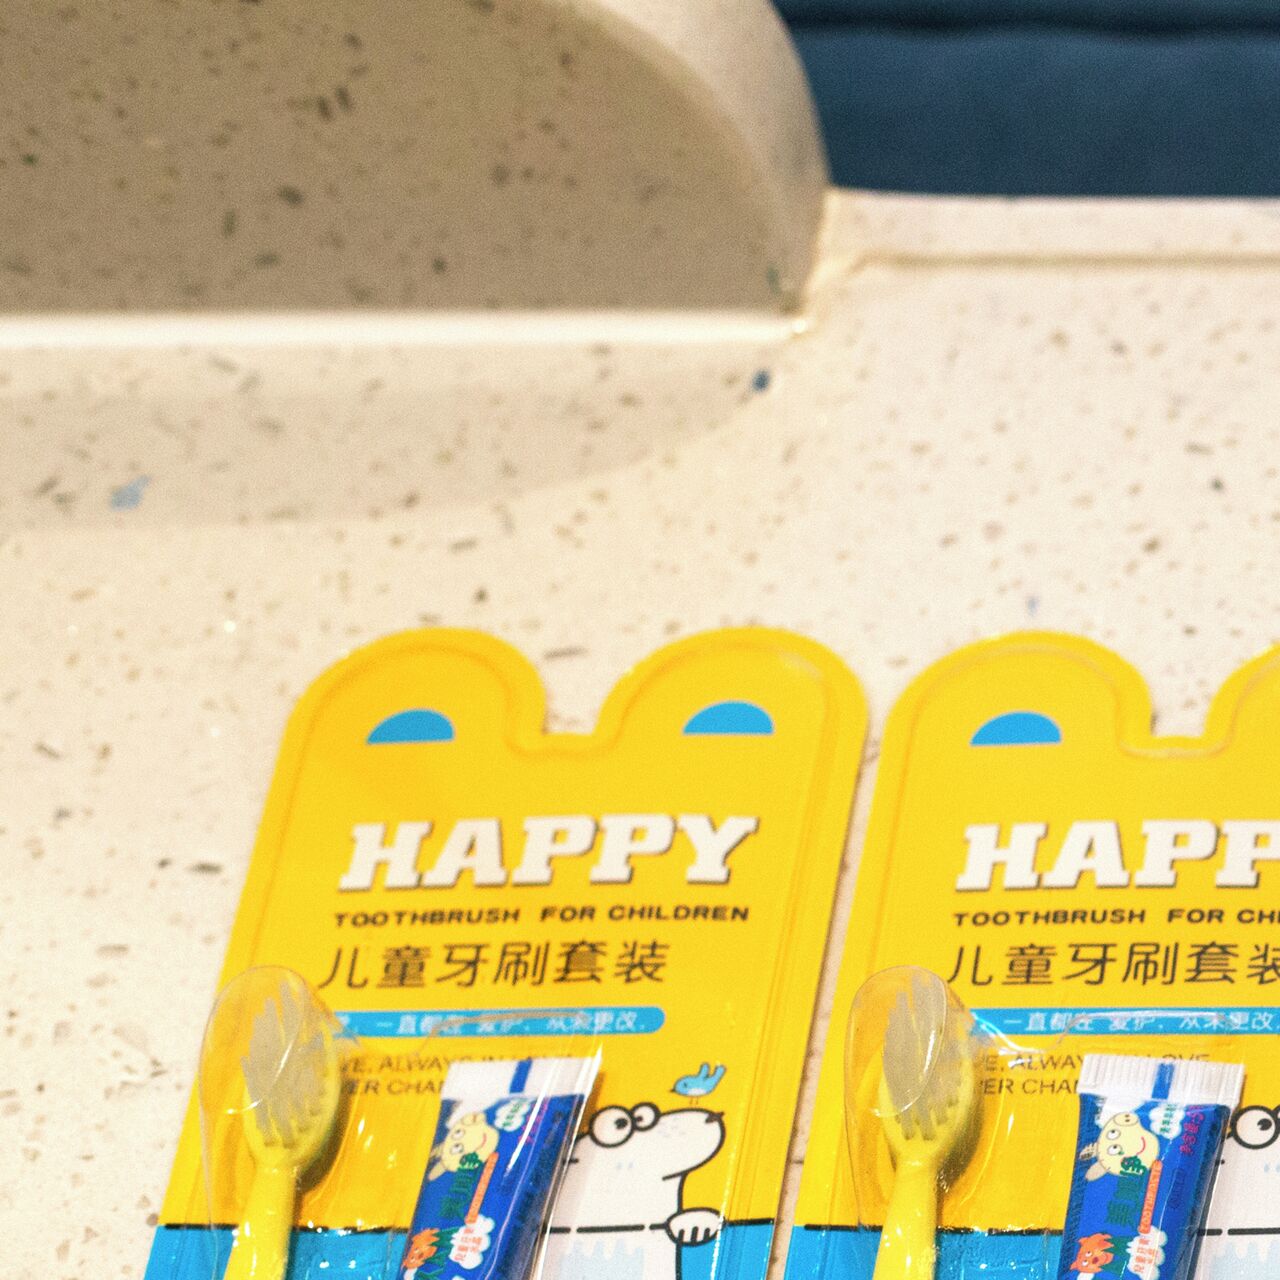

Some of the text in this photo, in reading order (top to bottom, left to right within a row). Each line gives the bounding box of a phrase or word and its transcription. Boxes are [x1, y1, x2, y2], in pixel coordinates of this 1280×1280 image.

[337, 813, 758, 892] HAPPY
[334, 905, 750, 928] TOOTHBRUSH FOR CHILDREN
[954, 909, 1146, 928] TOOTHBRUSH
[1168, 909, 1224, 924] FOR
[317, 940, 670, 991] 儿童牙刷套装
